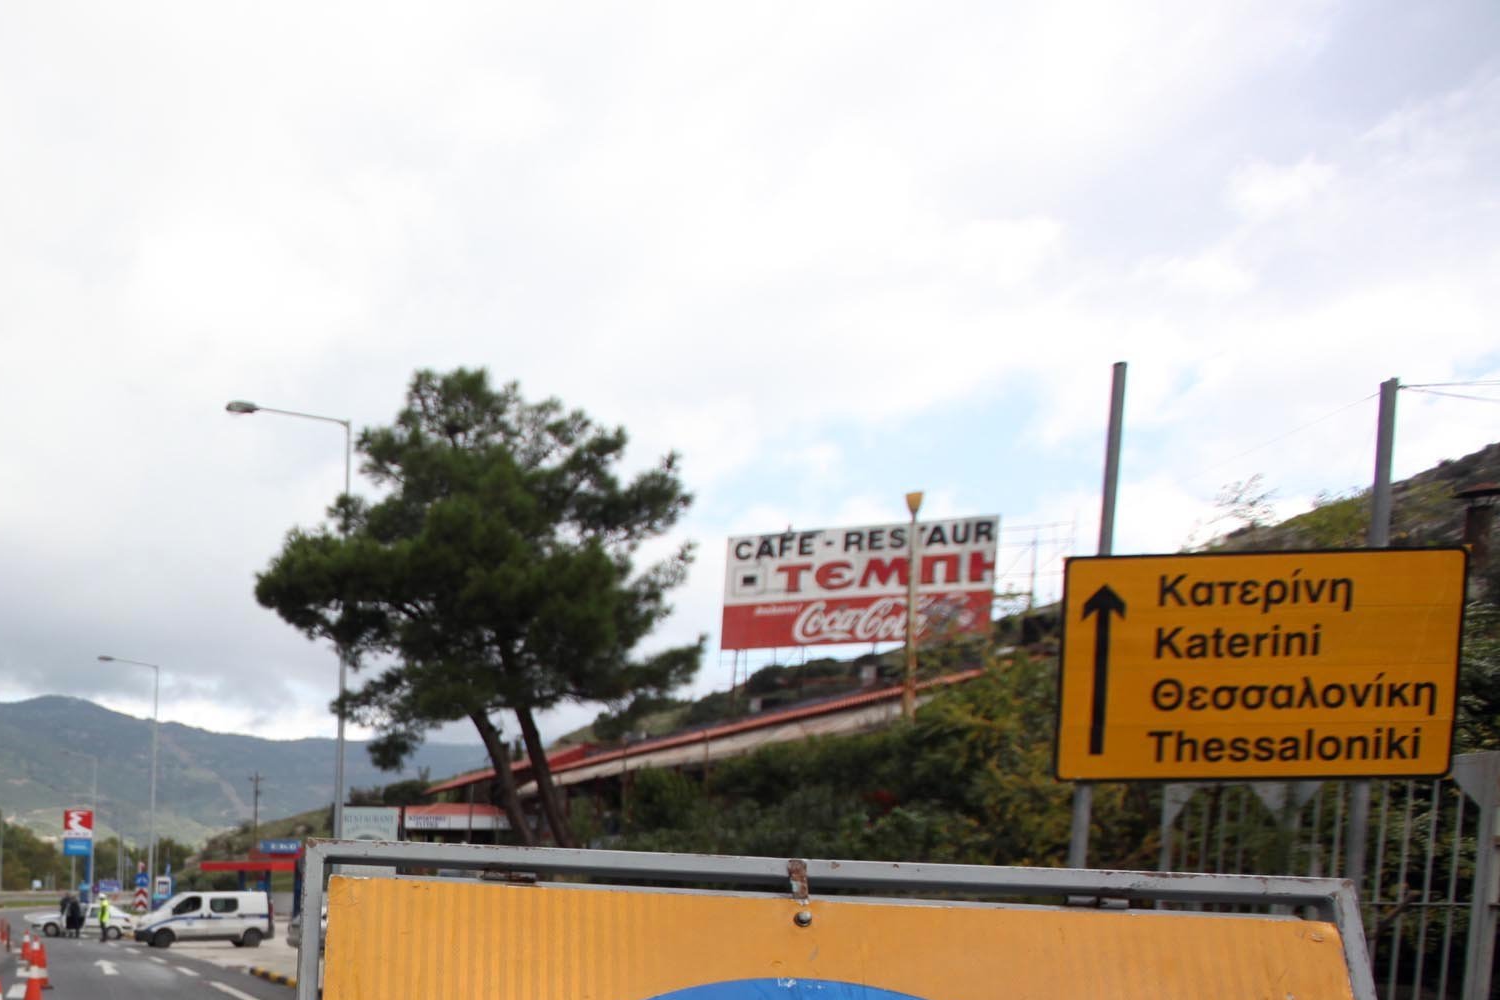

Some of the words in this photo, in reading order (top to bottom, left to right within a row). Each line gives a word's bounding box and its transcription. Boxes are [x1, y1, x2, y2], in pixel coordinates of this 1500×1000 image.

[735, 532, 815, 561] CAFE
[843, 520, 994, 552] RESAUR
[1158, 568, 1354, 614] Κατερίνη
[1154, 624, 1322, 659] Katerini
[1150, 672, 1438, 716] Θεσσαλονίκη
[1147, 727, 1422, 764] Thessaloniki
